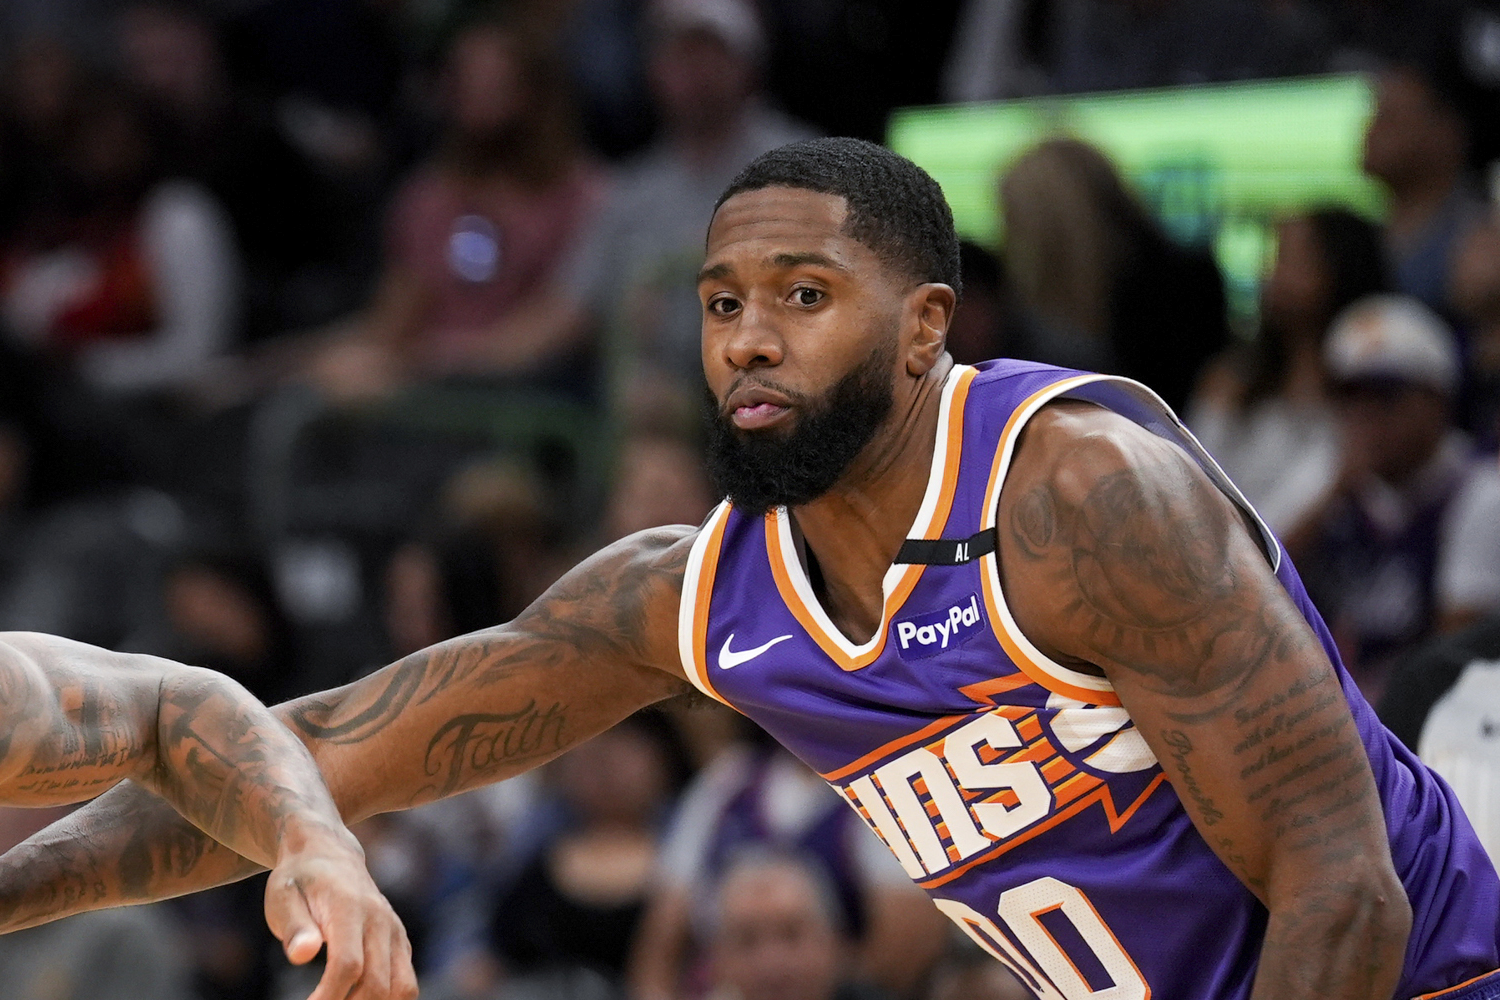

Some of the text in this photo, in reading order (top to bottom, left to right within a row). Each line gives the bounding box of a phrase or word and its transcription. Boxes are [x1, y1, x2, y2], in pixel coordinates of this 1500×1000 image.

[955, 542, 971, 562] AL
[897, 595, 981, 650] PayPal
[425, 699, 571, 796] Faith
[828, 712, 1054, 880] UNS
